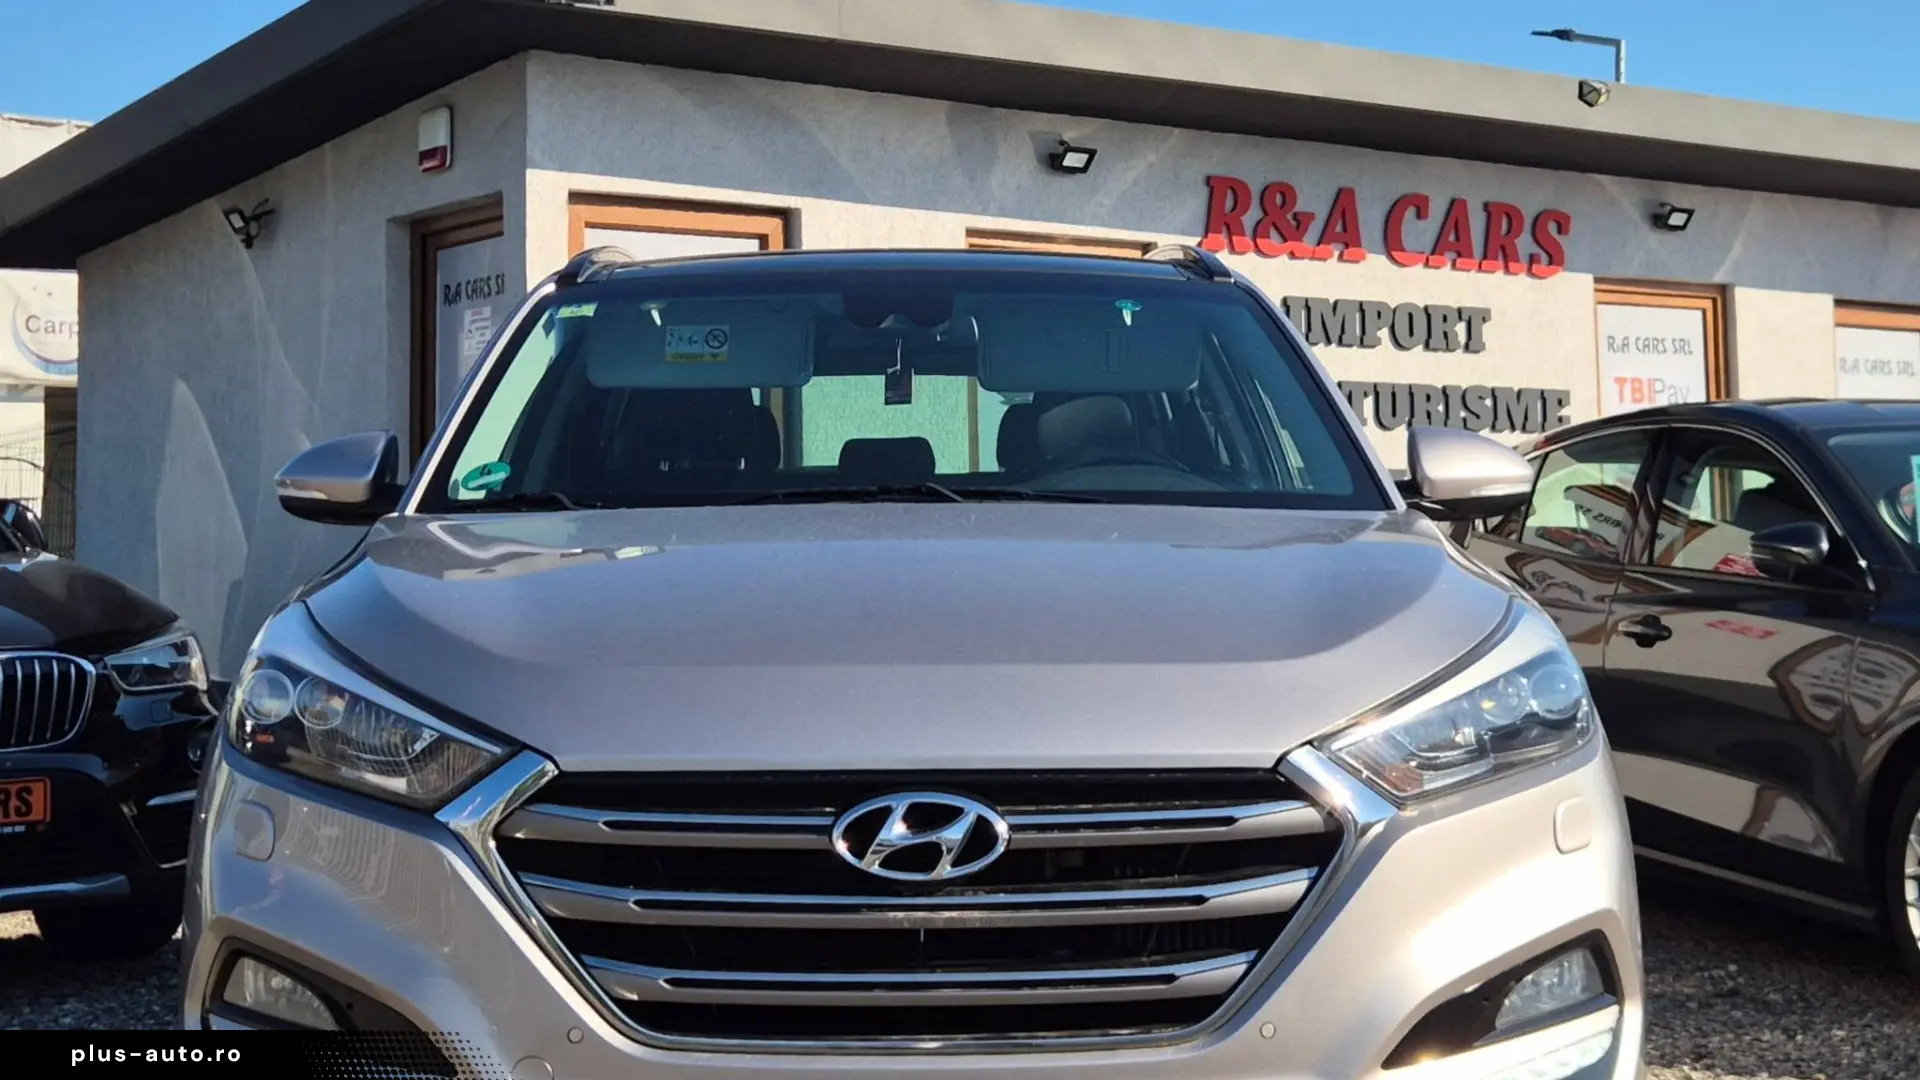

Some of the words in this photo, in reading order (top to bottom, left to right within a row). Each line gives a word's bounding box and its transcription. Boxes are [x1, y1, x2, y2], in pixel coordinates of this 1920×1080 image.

[1201, 175, 1367, 263] R&A
[1383, 192, 1571, 279] CARS
[465, 275, 493, 301] CARS
[1281, 295, 1492, 354] IMPORT
[1634, 336, 1667, 355] CARS
[1671, 337, 1694, 356] SRL
[1864, 358, 1892, 376] CARS
[1896, 359, 1915, 377] SRL
[1337, 380, 1571, 433] TURISME
